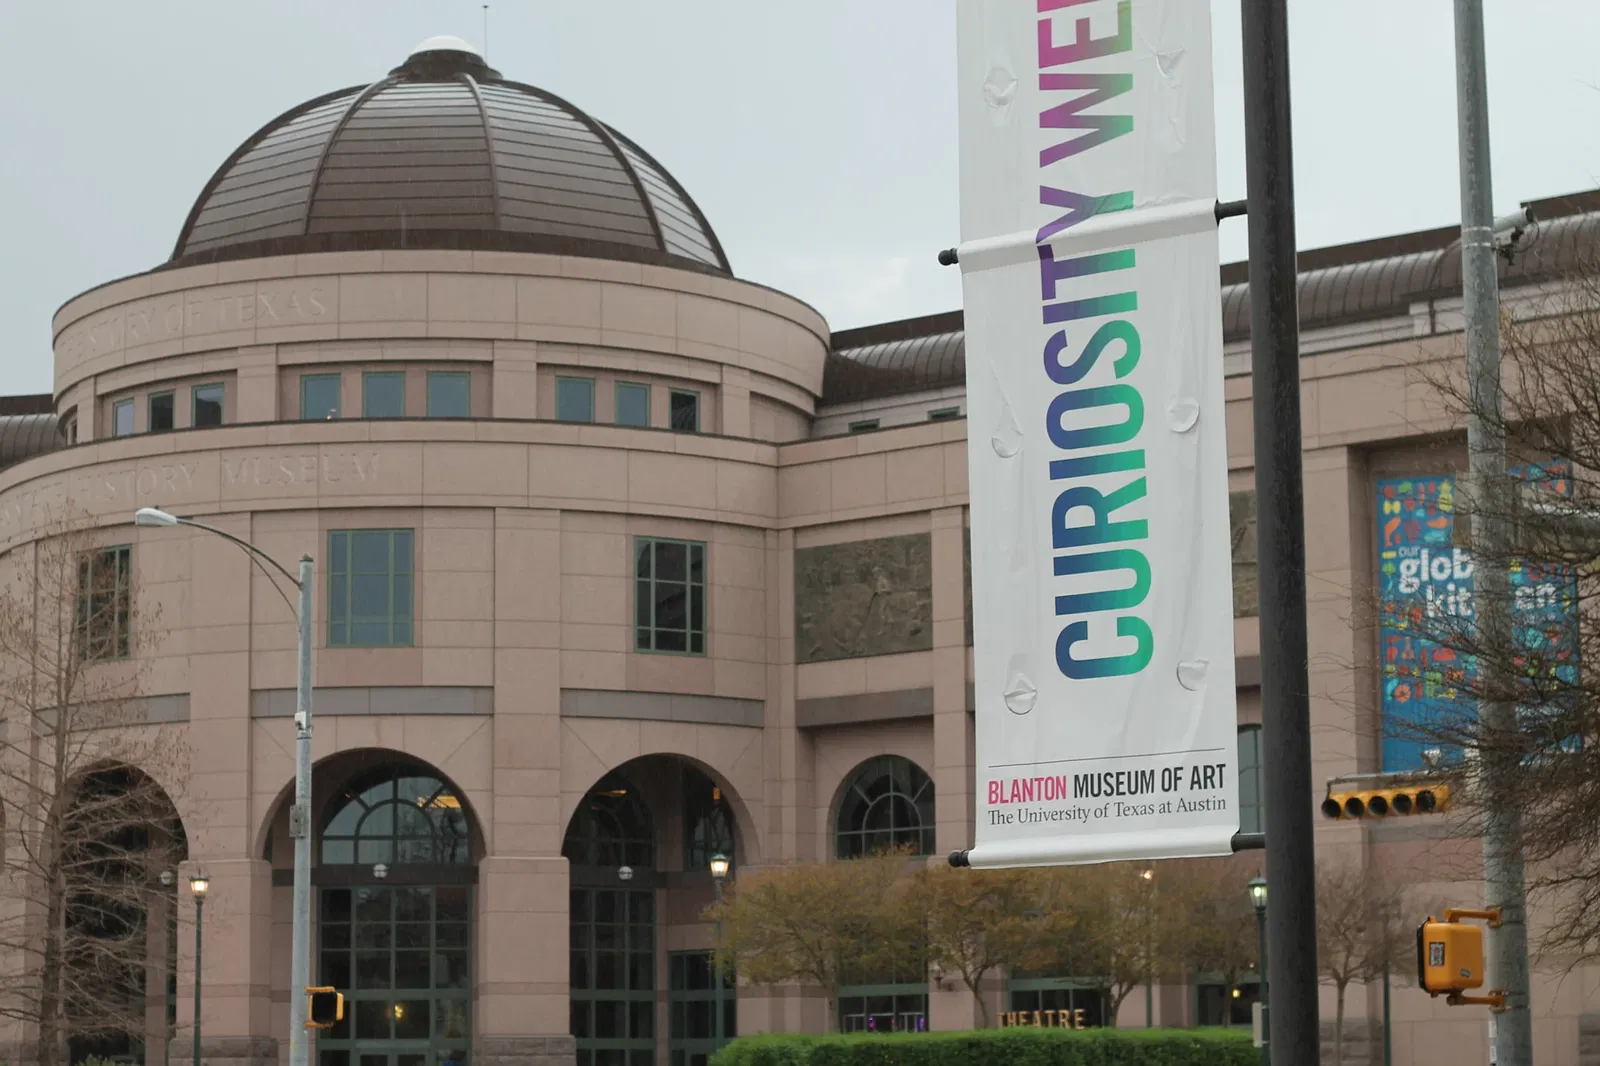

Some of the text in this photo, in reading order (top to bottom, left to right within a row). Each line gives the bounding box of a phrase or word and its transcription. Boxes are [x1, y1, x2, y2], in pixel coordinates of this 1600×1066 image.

[164, 298, 203, 334] OF
[213, 287, 327, 324] TEXAS
[1036, 0, 1154, 680] CURIOSITY WE
[222, 451, 380, 488] MUSEUM
[988, 764, 1226, 804] BLANTON MUSEUM OF ART
[988, 797, 1226, 826] The University of Texas at Austin
[996, 1008, 1087, 1031] THEATRE
